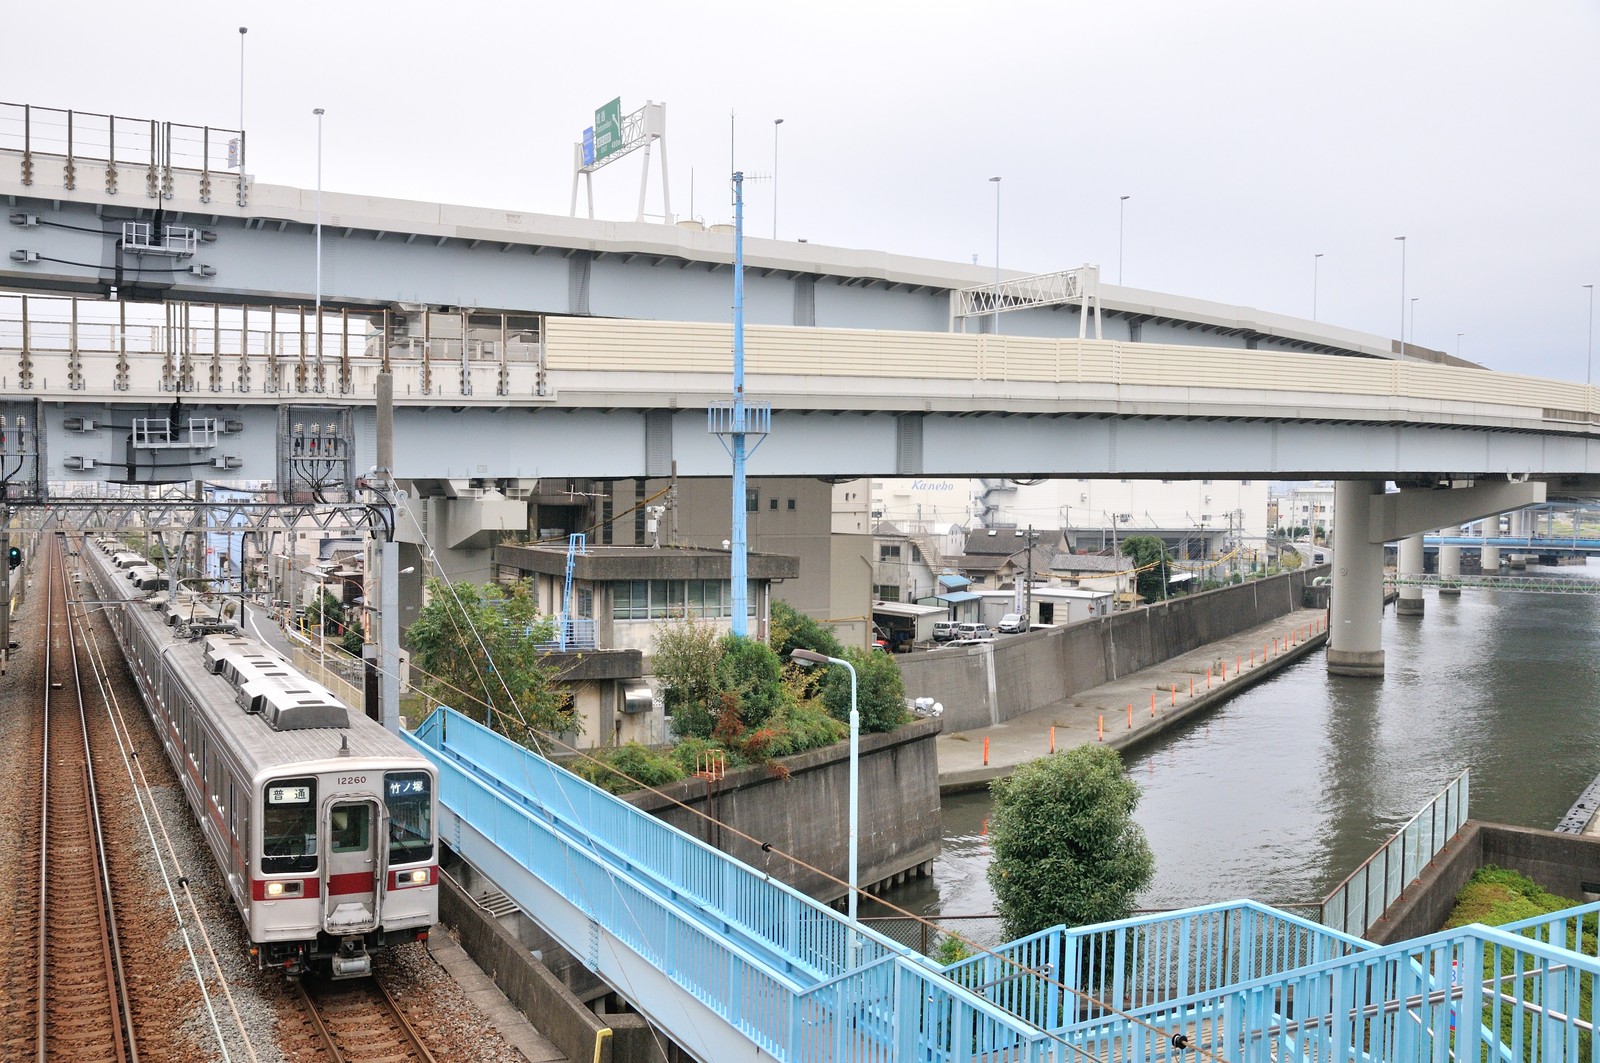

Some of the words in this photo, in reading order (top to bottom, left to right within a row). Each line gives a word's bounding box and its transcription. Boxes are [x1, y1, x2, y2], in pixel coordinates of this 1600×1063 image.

[911, 480, 954, 490] Kanebo
[337, 776, 367, 785] 12260
[390, 780, 423, 794] 竹ノ塚
[273, 788, 306, 801] 普通
